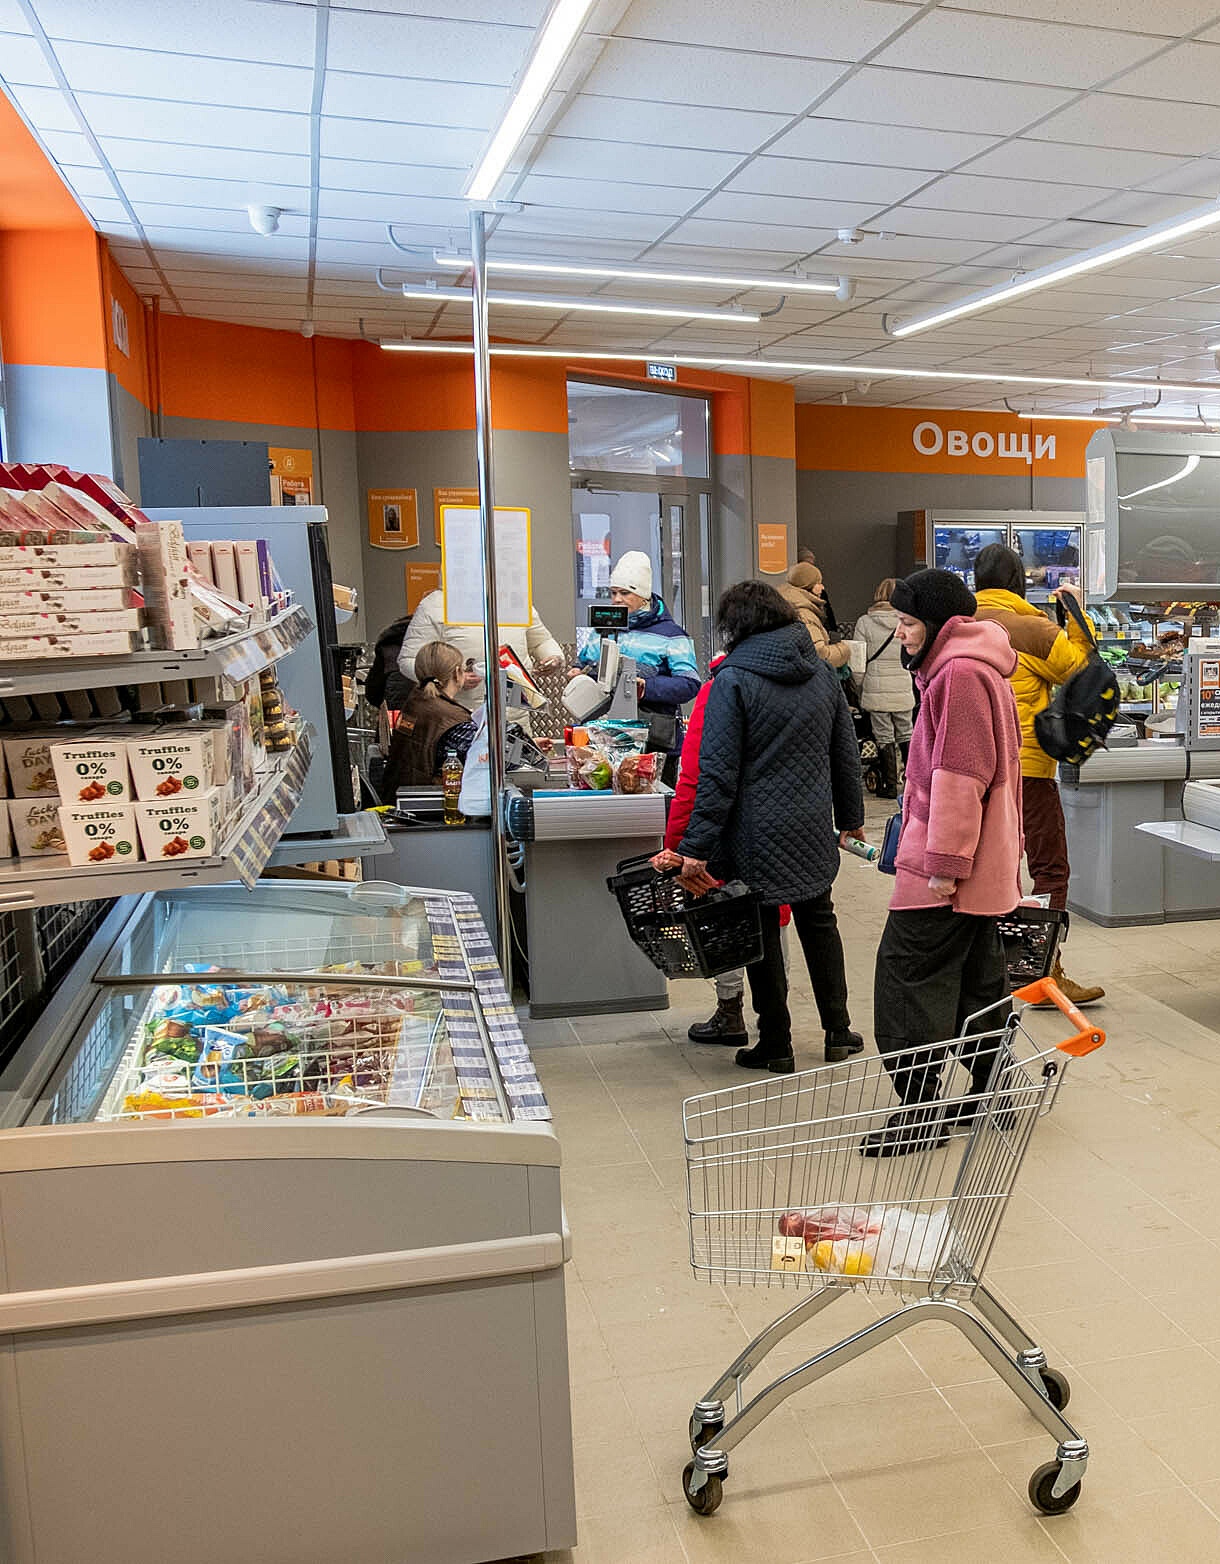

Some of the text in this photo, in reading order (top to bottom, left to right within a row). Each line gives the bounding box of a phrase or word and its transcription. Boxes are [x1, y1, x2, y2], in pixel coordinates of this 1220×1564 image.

[912, 421, 1057, 465] Овощи
[62, 750, 116, 760] Truffles
[138, 745, 191, 755] Truffles
[76, 762, 107, 776] 0%
[152, 757, 183, 771] 0%
[71, 810, 125, 821] Truffles
[145, 805, 198, 816] Truffles
[84, 822, 116, 836] 0%
[159, 817, 190, 831] 0%
